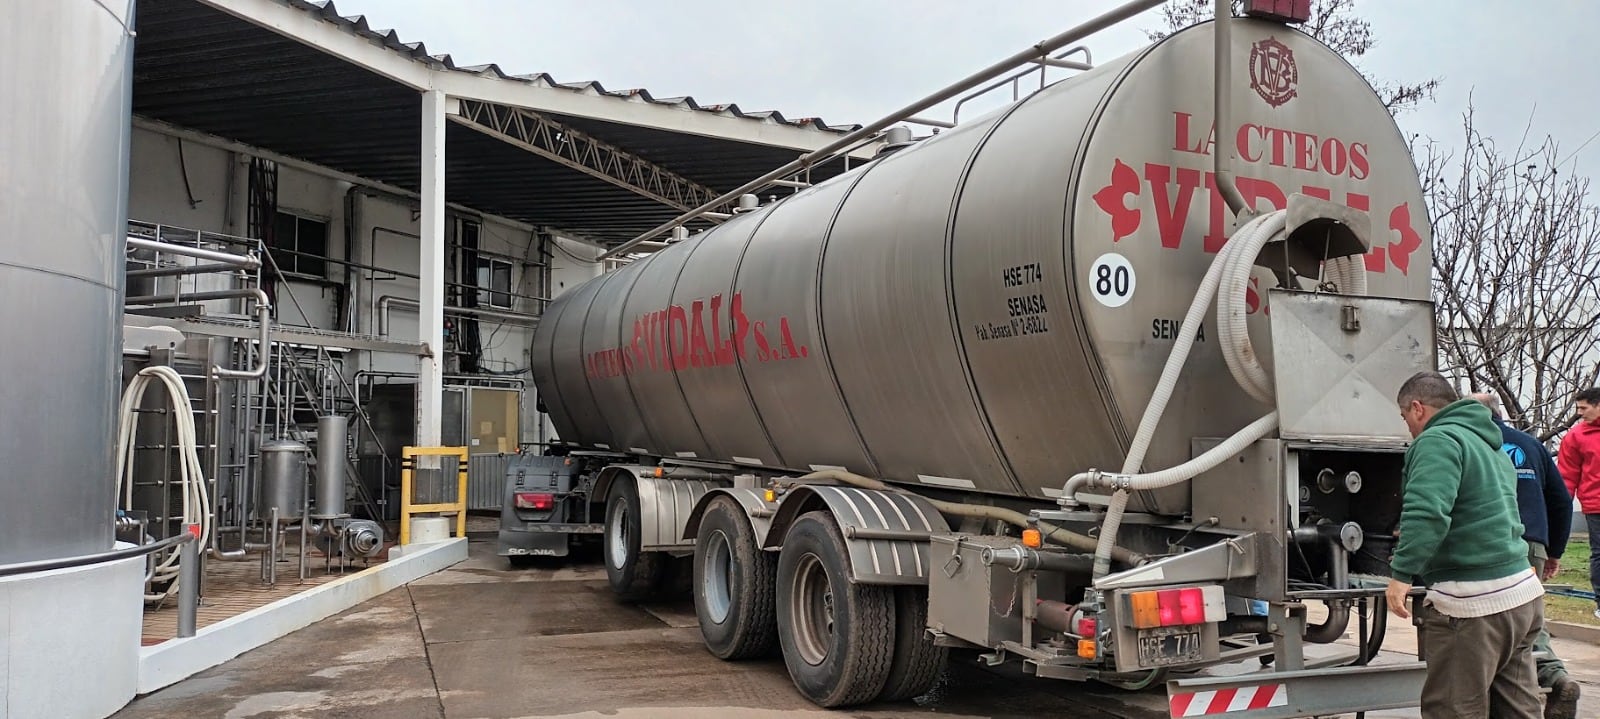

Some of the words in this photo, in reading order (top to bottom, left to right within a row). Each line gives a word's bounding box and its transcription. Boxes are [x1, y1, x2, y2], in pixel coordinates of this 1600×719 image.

[1003, 267, 1023, 288] HSE
[1024, 262, 1042, 284] 774
[1096, 264, 1130, 297] 80
[1007, 294, 1047, 317] SENASA
[642, 292, 738, 372] VIDAL
[753, 315, 808, 363] S.A.
[1152, 318, 1205, 342] SENA
